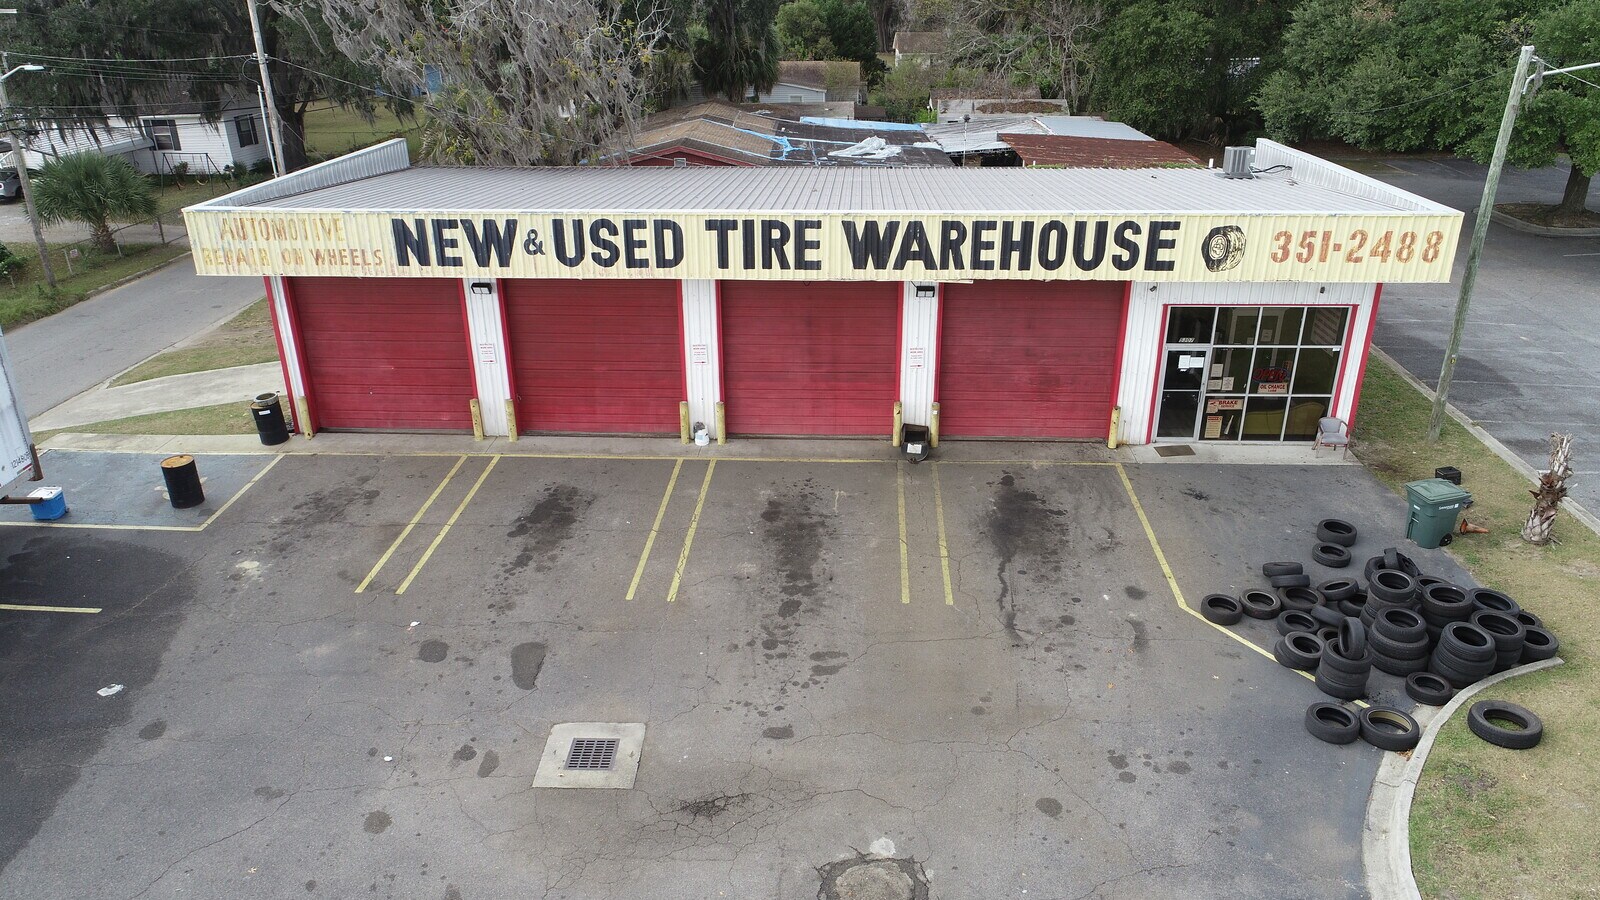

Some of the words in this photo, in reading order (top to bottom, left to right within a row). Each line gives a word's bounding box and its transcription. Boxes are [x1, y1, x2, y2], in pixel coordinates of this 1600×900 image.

[220, 217, 344, 242] AUTOMOTIVE
[391, 218, 518, 268] NEW
[524, 228, 546, 256] &
[552, 218, 684, 269] USED
[705, 219, 822, 270] TIRE
[842, 220, 1182, 271] WAREHOUSE
[202, 248, 270, 267] REPAIR
[282, 248, 305, 267] ON
[311, 248, 383, 267] WHEELS
[1270, 229, 1444, 264] 351-2488
